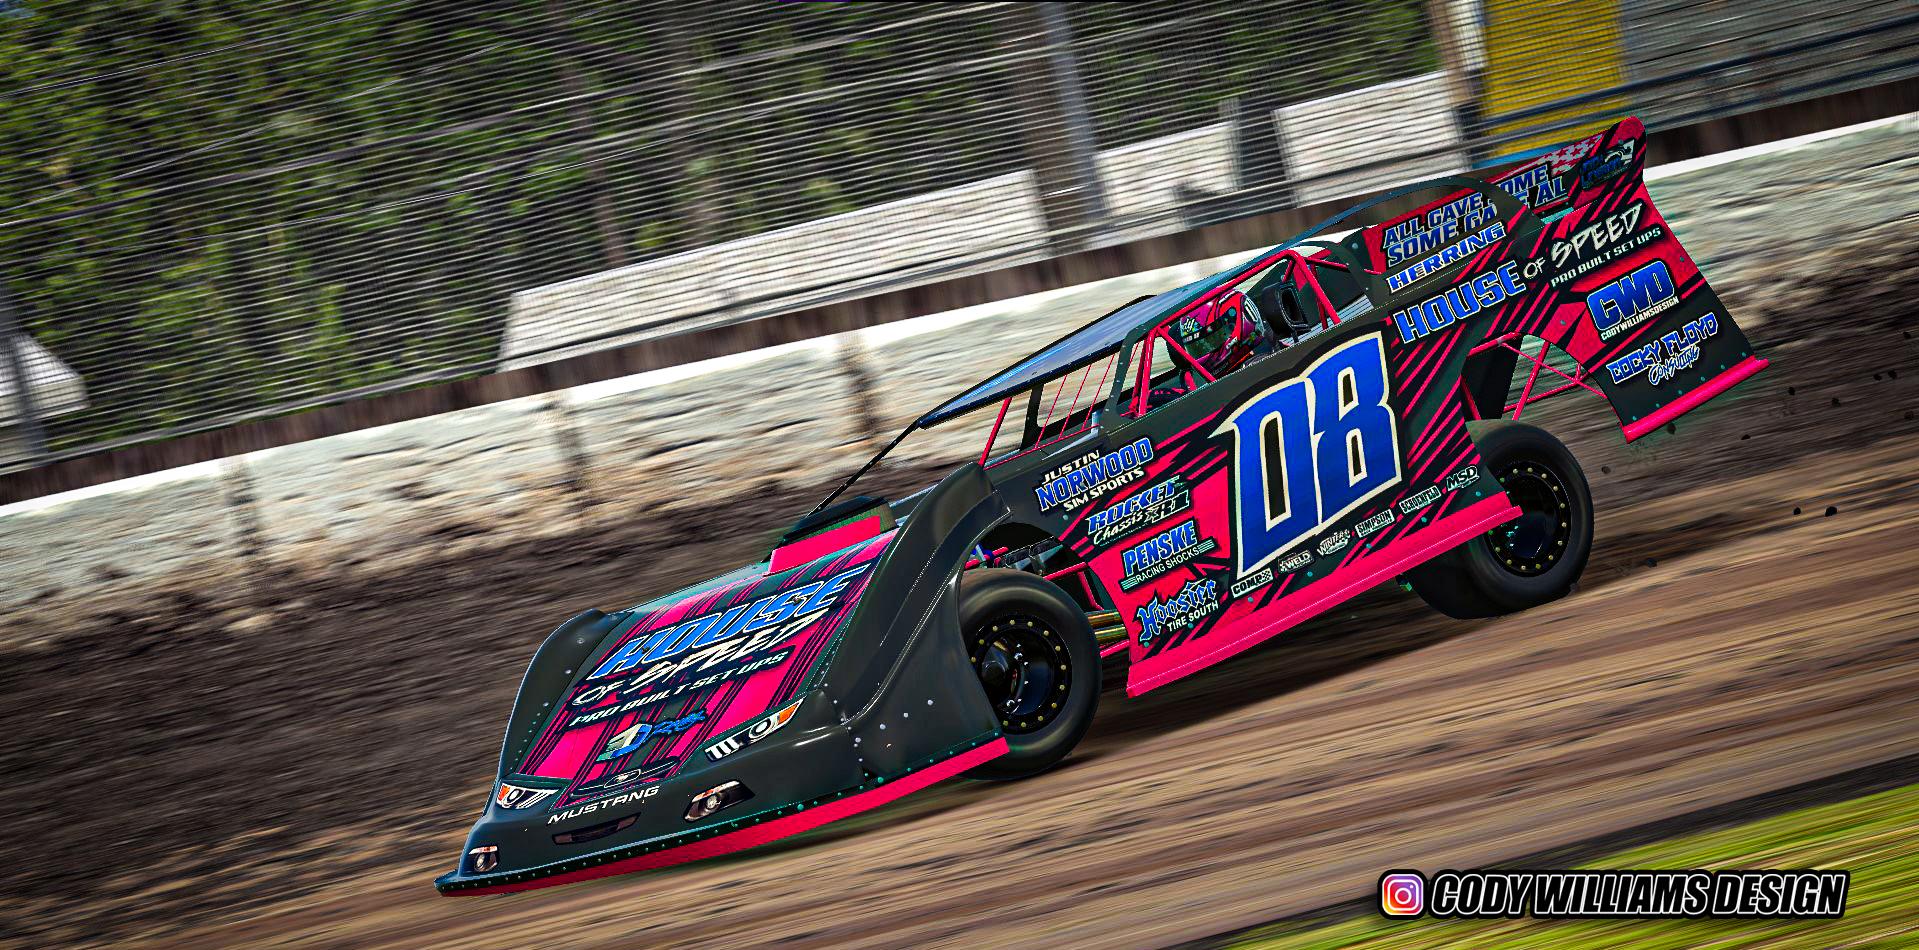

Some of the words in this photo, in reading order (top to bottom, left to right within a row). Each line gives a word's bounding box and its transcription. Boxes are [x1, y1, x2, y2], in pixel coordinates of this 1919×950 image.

[1383, 217, 1424, 248] ALL
[1428, 192, 1486, 228] GAVE
[1496, 164, 1549, 196] OME
[1387, 222, 1460, 267] SOME
[1387, 222, 1506, 293] HERRING
[1551, 269, 1576, 287] PRO
[1578, 251, 1610, 272] BUILT
[1614, 241, 1634, 256] SET
[1638, 228, 1661, 244] UPS
[1394, 260, 1527, 343] HOUSE
[1523, 257, 1545, 278] OF
[1551, 203, 1643, 268] SPEED
[1587, 260, 1674, 331] CWD
[1601, 296, 1680, 340] CODYWILLIAMSDESIGN
[1606, 340, 1661, 384] COCKY
[1661, 312, 1718, 355] FLOYD
[1036, 437, 1153, 511] NORWOOD
[1042, 450, 1100, 484] JUSTIN
[1208, 331, 1402, 580] 08
[1447, 466, 1479, 490] MSD
[1063, 494, 1089, 511] SIM
[1090, 467, 1144, 499] SPORTS
[1086, 481, 1176, 535] ROCKET
[1093, 511, 1144, 545] Chassis
[1123, 520, 1197, 578] PENSKE
[1356, 511, 1391, 532] SIMPSON
[1136, 563, 1165, 581] RACING
[1166, 547, 1199, 569] SHOCKS
[1232, 573, 1265, 594] COMP
[1285, 552, 1311, 569] WELD
[586, 563, 871, 681] HOUSE
[1137, 578, 1217, 641] Hoosier
[1167, 616, 1187, 632] TIRE
[1189, 600, 1219, 622] SOUTH
[572, 679, 625, 706] OF
[623, 608, 829, 695] SPEED
[569, 705, 621, 726] PRO
[620, 683, 691, 712] BUILT
[689, 668, 738, 690] SET
[736, 652, 788, 675] UPS
[548, 785, 660, 825] MUSTANG
